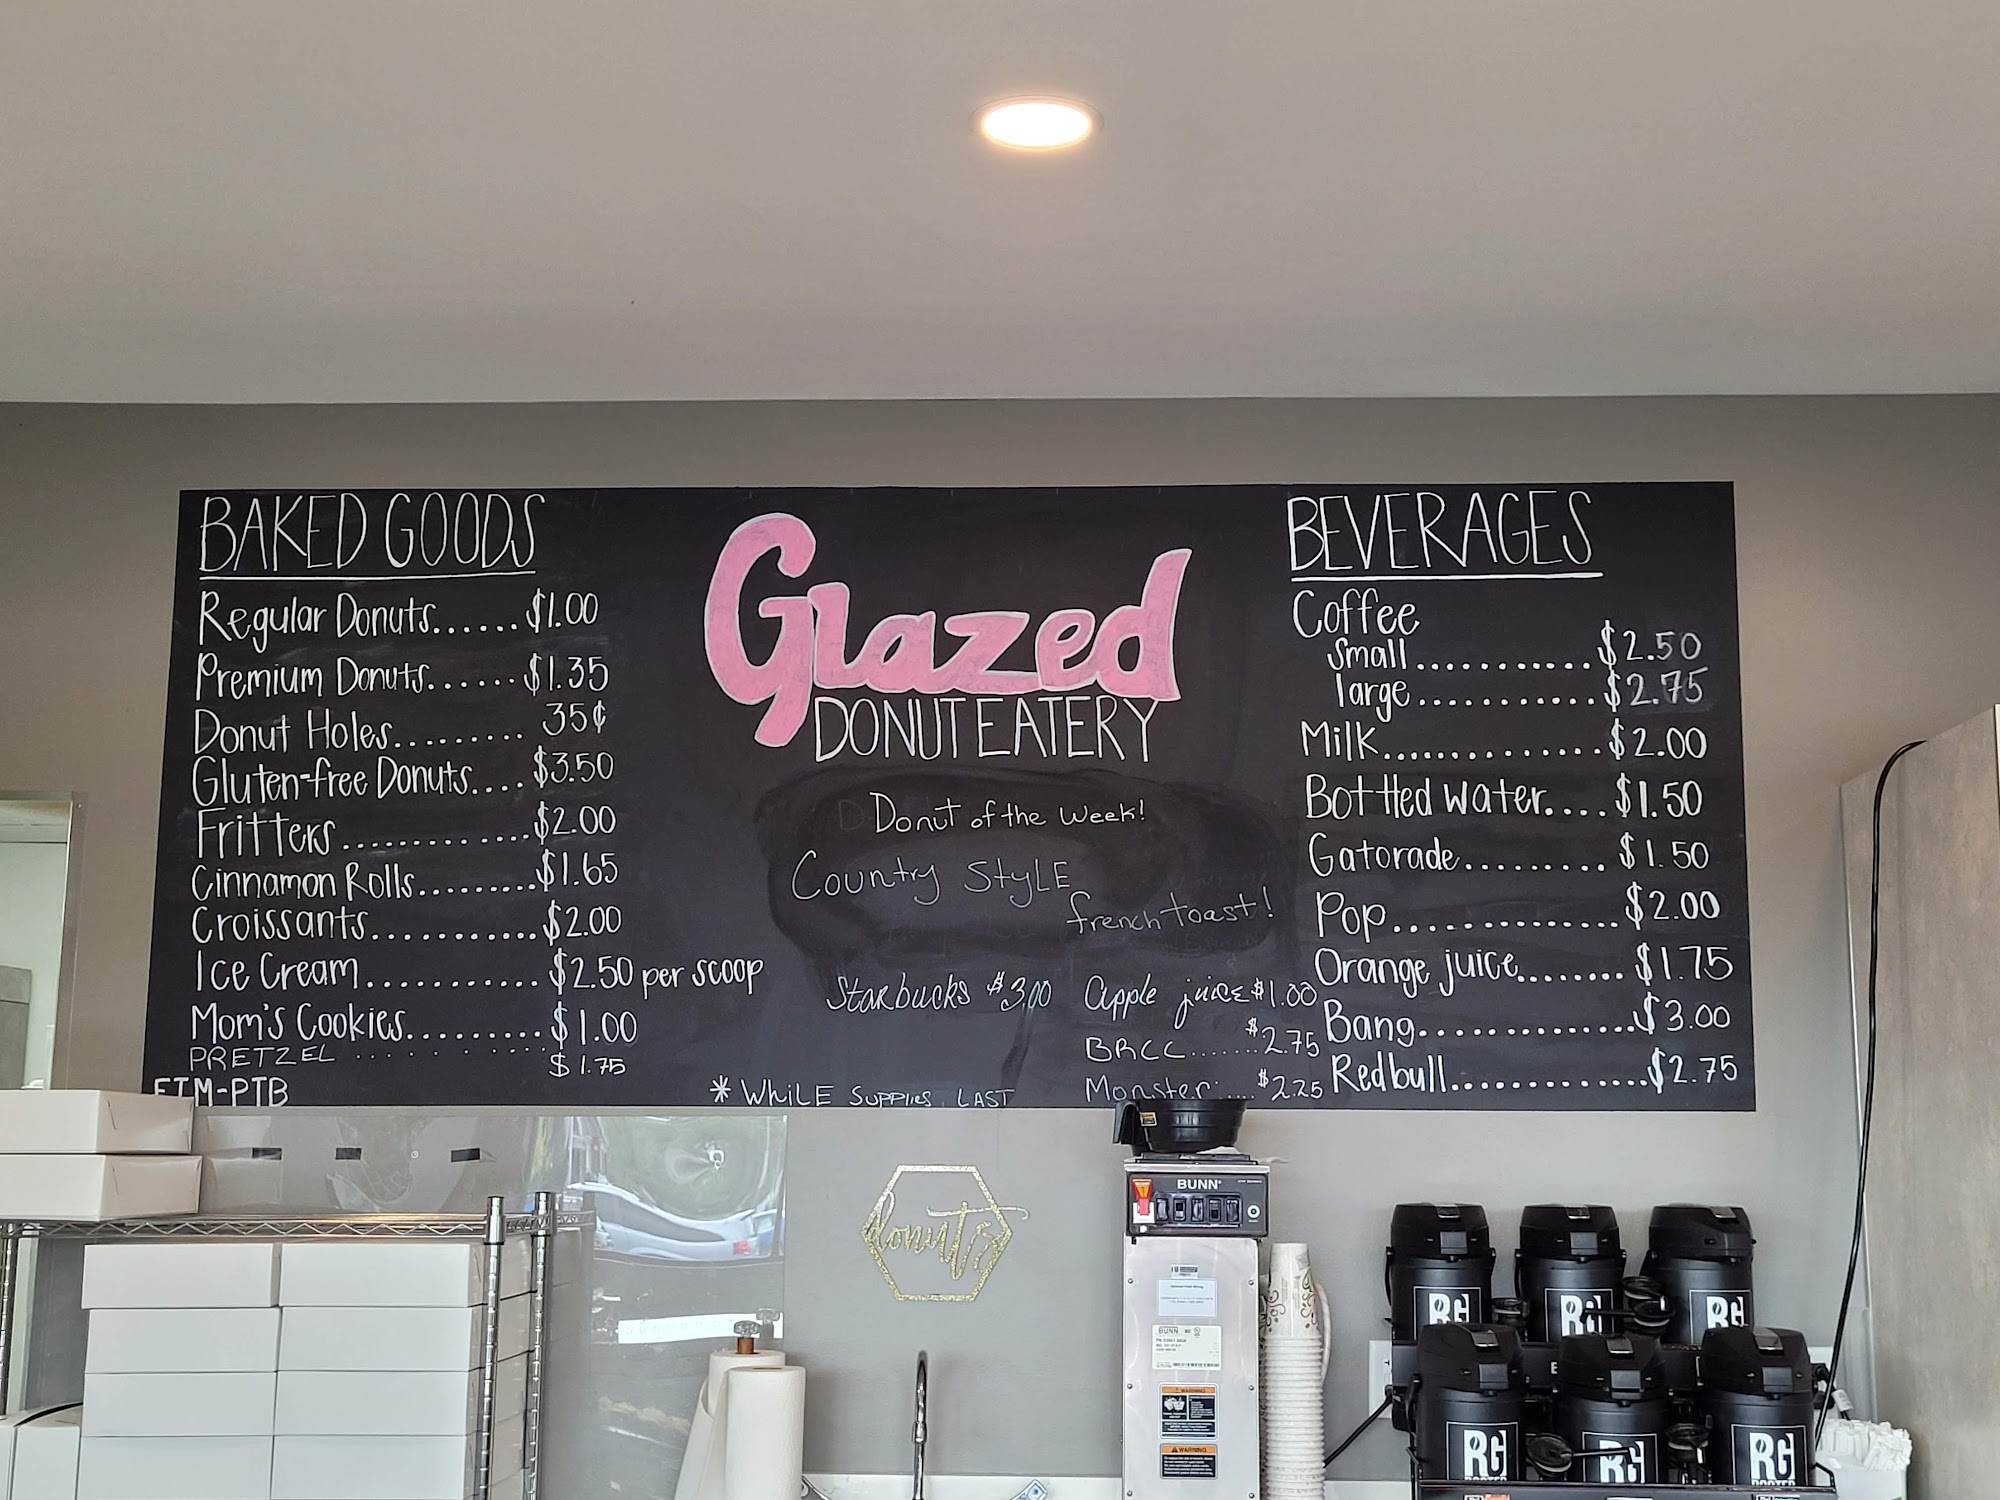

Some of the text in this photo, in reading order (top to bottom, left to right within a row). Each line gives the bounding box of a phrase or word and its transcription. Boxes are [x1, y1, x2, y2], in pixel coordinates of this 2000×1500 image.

[200, 492, 545, 573] BAKED GOODS
[1287, 490, 1592, 571] BEVERAGES
[200, 590, 328, 653] Regular
[526, 588, 598, 634] $1.00
[704, 512, 1193, 747] Glazed
[1293, 588, 1420, 638] Coffee
[1597, 620, 1702, 669] $2.50
[196, 653, 323, 701] Premium
[523, 652, 609, 696] $1.35
[1603, 666, 1709, 712] $2.75
[194, 700, 607, 754] Donut Holes 35¢
[814, 693, 1160, 763] DONUT EATERY
[1301, 717, 1707, 762] Milk $2.00
[192, 755, 368, 806] Gluten-free
[533, 745, 614, 790] $3.50
[1305, 773, 1432, 819] Bottled
[1615, 772, 1703, 818] $1.50
[197, 801, 616, 859] Fritters $2.00
[869, 791, 961, 834] Donut
[970, 802, 997, 829] of
[1000, 799, 1046, 828] the
[191, 865, 336, 901] Cinnamon
[536, 850, 619, 892] $1.65
[791, 850, 941, 905] Country
[1308, 832, 1709, 877] Gatorade $1.50
[191, 900, 623, 946] Croissants $2.00
[1316, 881, 1720, 943] Pop $2.00
[196, 947, 764, 999] Ice Cream $2.50 per scoop
[826, 973, 972, 1013] Starbucks
[1251, 977, 1318, 1008] $1.00
[1314, 947, 1431, 999] Orange
[1635, 942, 1734, 987] $1.75
[550, 1001, 639, 1049] $1.00
[1324, 992, 1731, 1047] Bang $3.00
[189, 1044, 626, 1078] PRETZEL $1.75
[1647, 1047, 1738, 1094] $2.75
[957, 1088, 1015, 1108] LAST
[1177, 1179, 1218, 1190] BUNN
